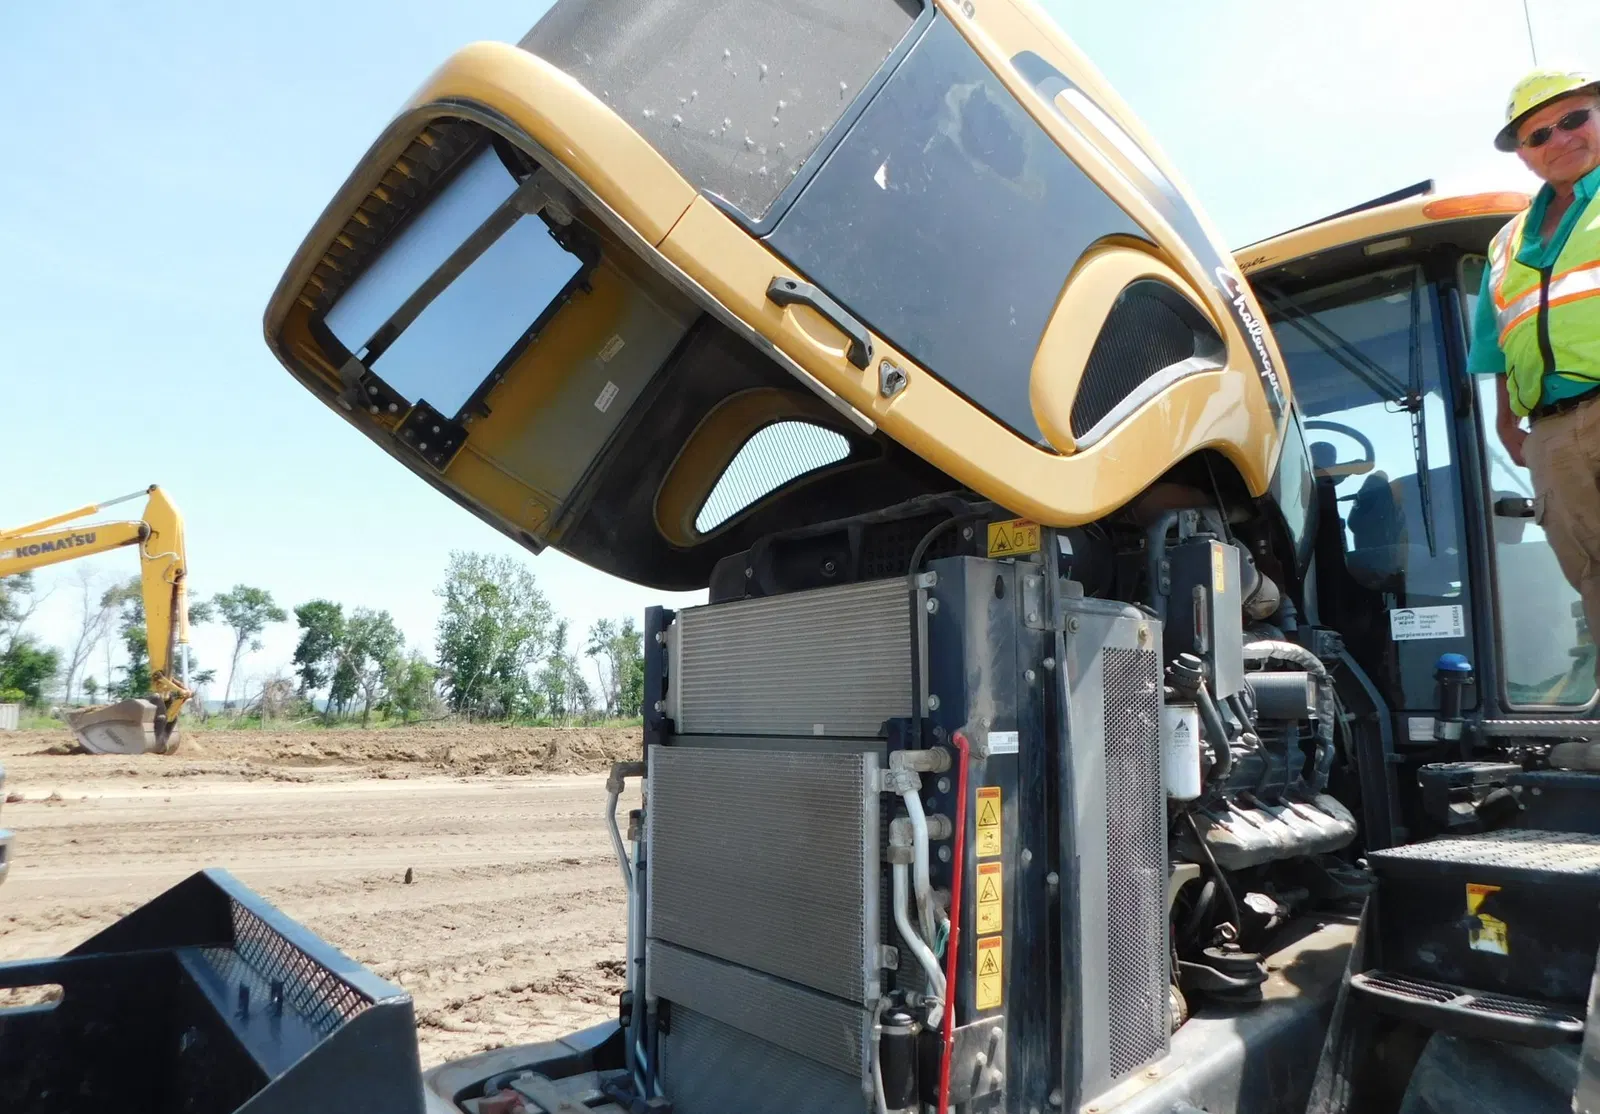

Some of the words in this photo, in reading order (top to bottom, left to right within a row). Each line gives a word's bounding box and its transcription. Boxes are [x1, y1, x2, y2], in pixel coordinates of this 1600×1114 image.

[1215, 266, 1285, 416] Challenger
[16, 532, 96, 558] KOMATSU
[1394, 613, 1414, 622] purple
